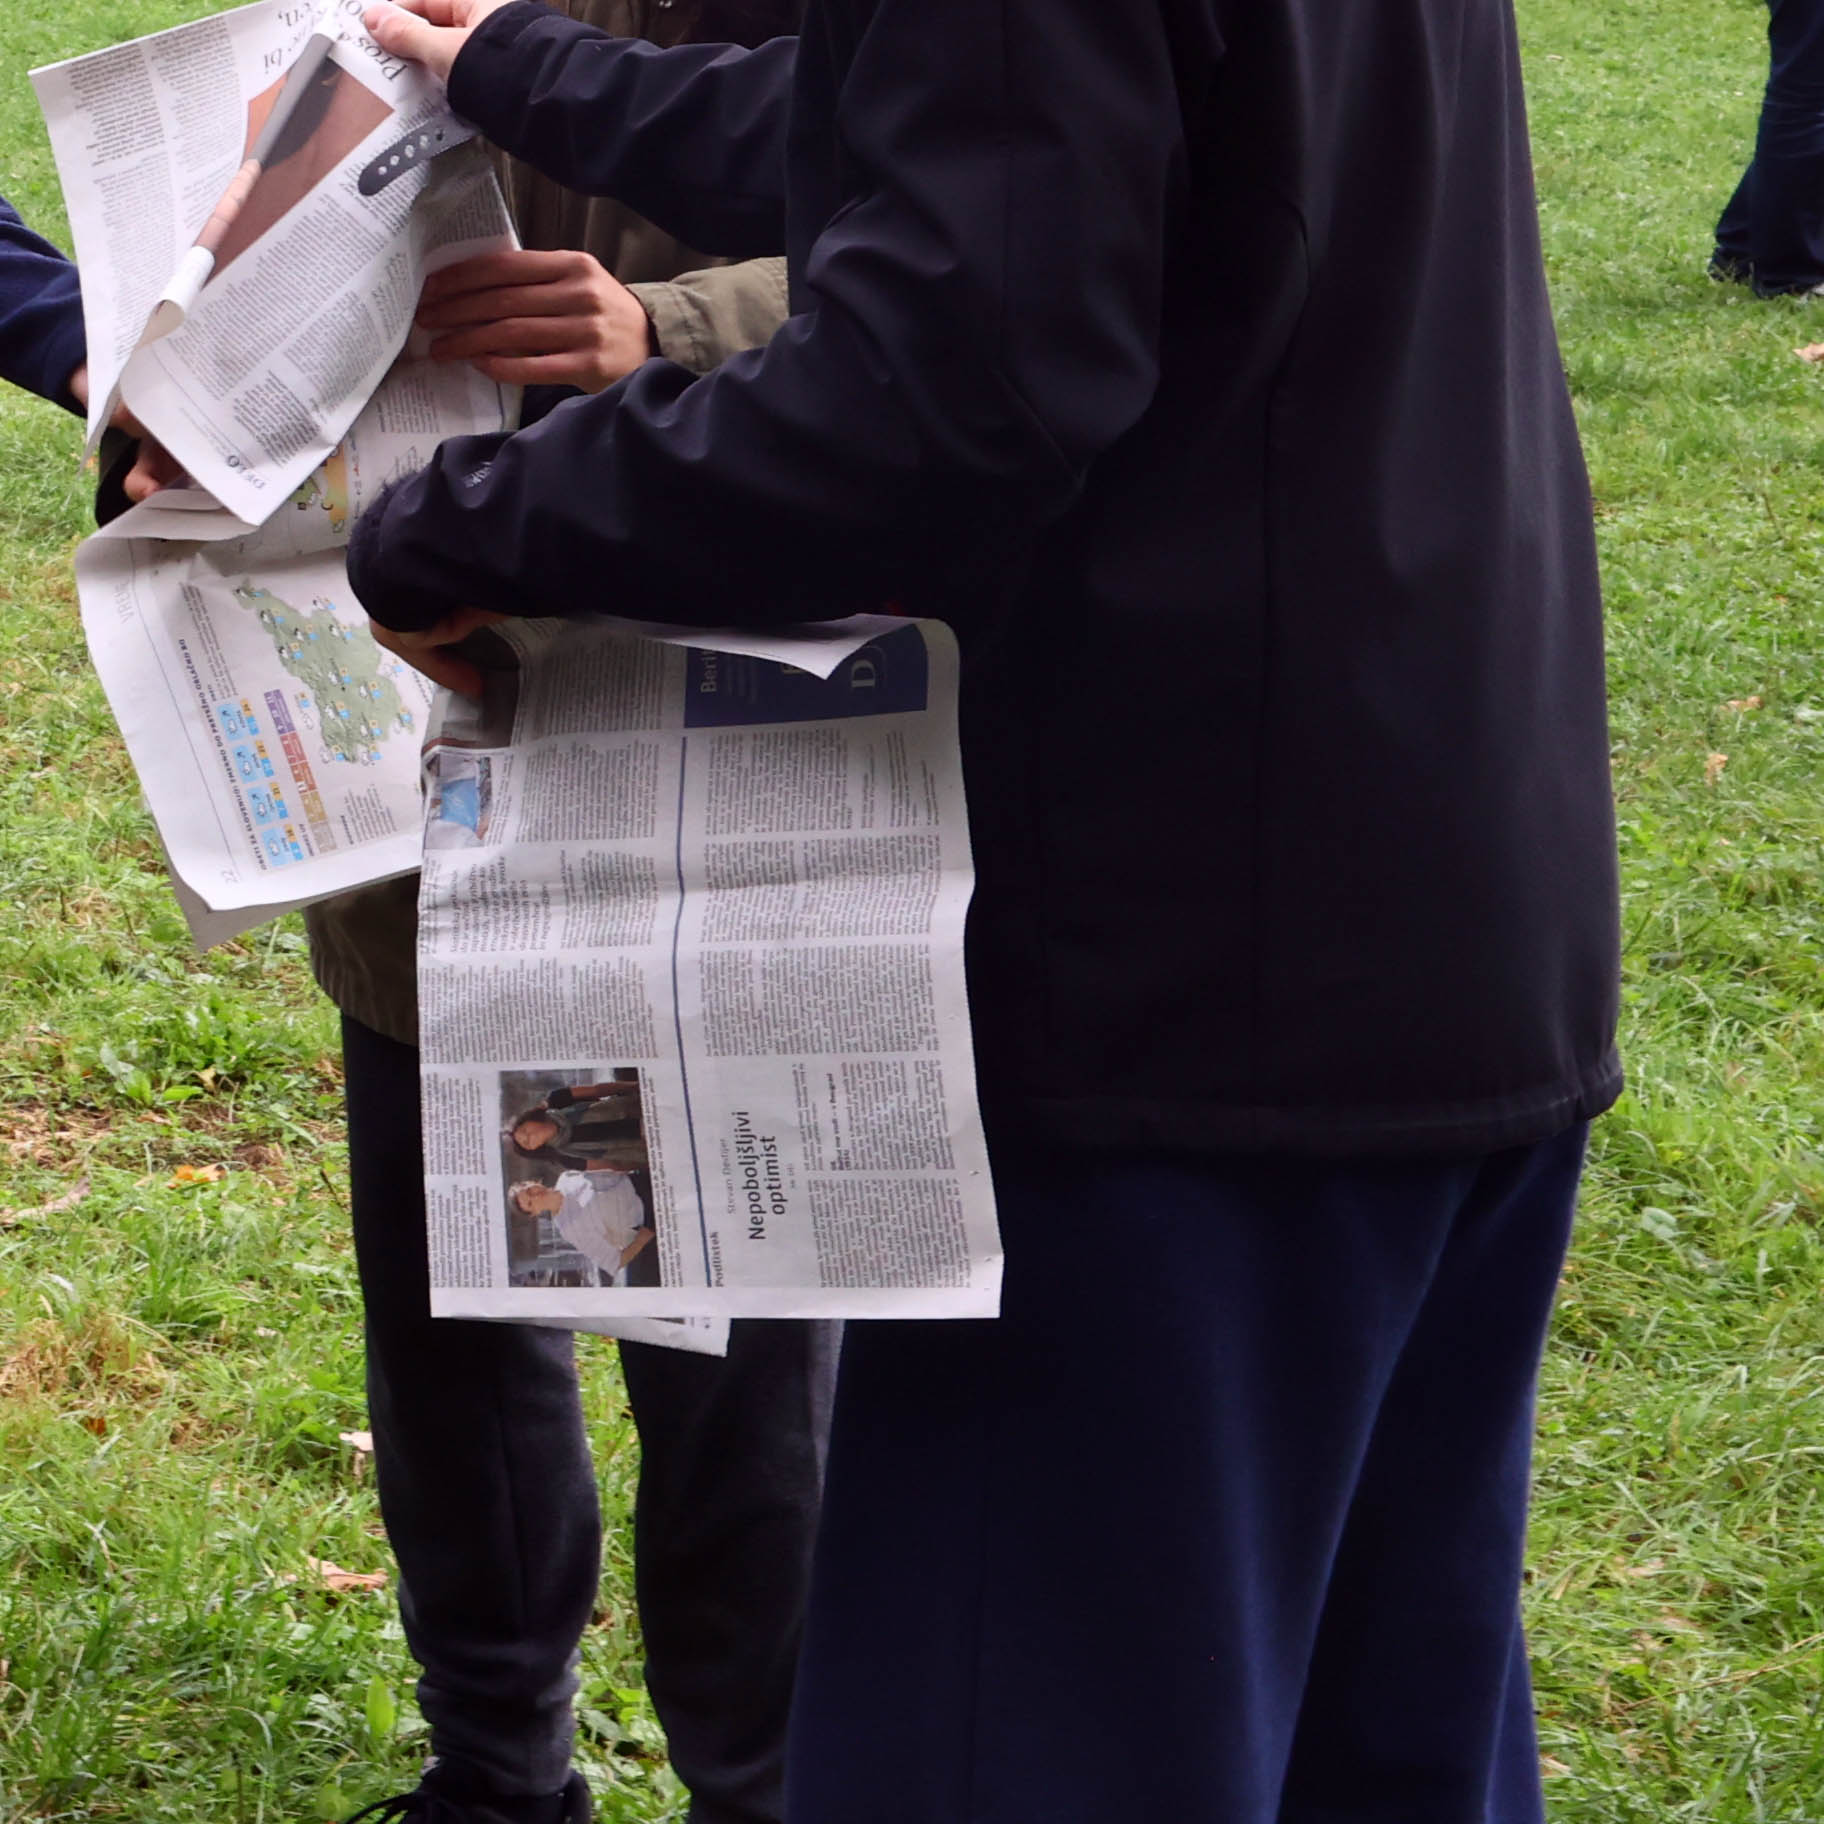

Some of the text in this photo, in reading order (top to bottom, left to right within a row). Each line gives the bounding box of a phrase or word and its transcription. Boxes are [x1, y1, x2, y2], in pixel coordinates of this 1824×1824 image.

[214, 734, 224, 747] DO
[731, 1111, 767, 1240] Nepoboljšljivi
[760, 1136, 788, 1216] optimist
